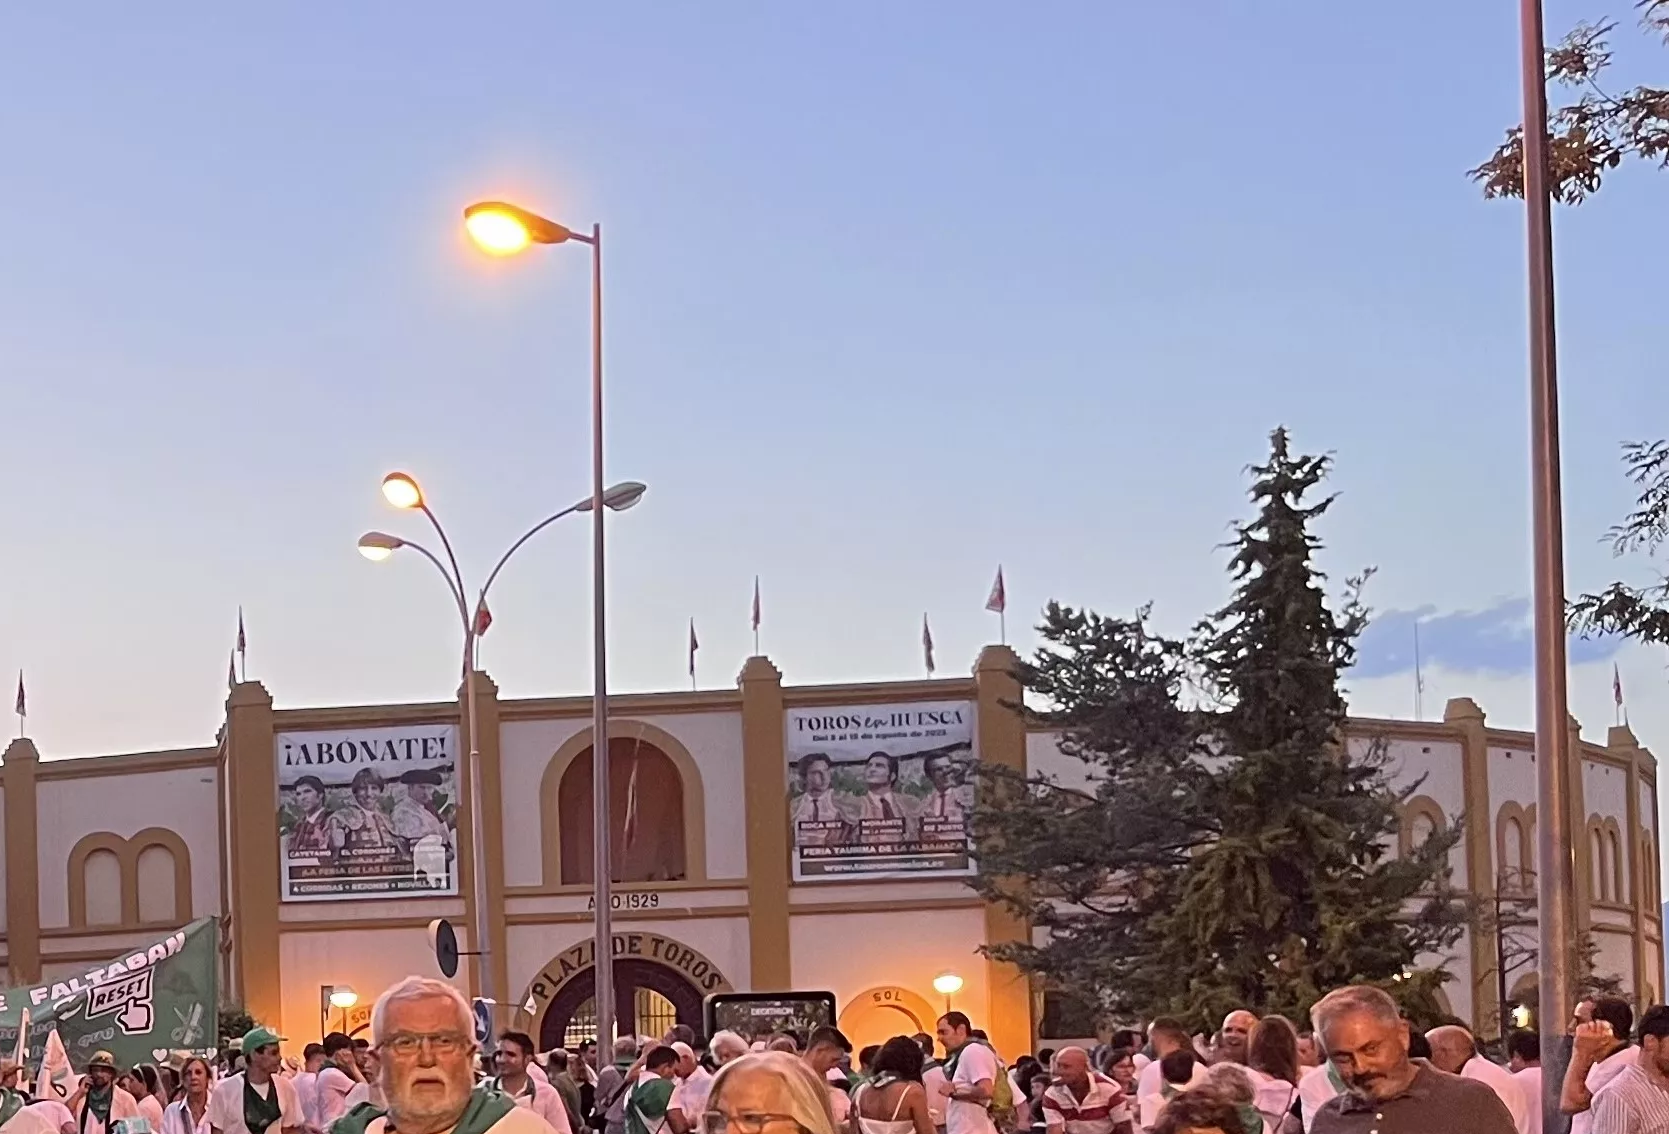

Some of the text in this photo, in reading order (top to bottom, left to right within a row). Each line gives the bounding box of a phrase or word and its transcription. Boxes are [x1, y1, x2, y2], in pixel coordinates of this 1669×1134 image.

[794, 710, 963, 732] TOROS en HUESCA
[284, 736, 447, 766] ¡ABÓNATE!
[800, 822, 824, 830] ROCA
[802, 846, 832, 856] FERIA
[833, 845, 876, 855] TAURINA
[878, 844, 893, 853] DE
[894, 843, 908, 852] LA
[588, 893, 660, 910] AO 1929
[29, 931, 186, 1007] FALTABAN
[612, 935, 643, 955] DE
[650, 936, 723, 990] TOROS
[95, 976, 146, 1007] RESET
[872, 991, 903, 1002] SOL
